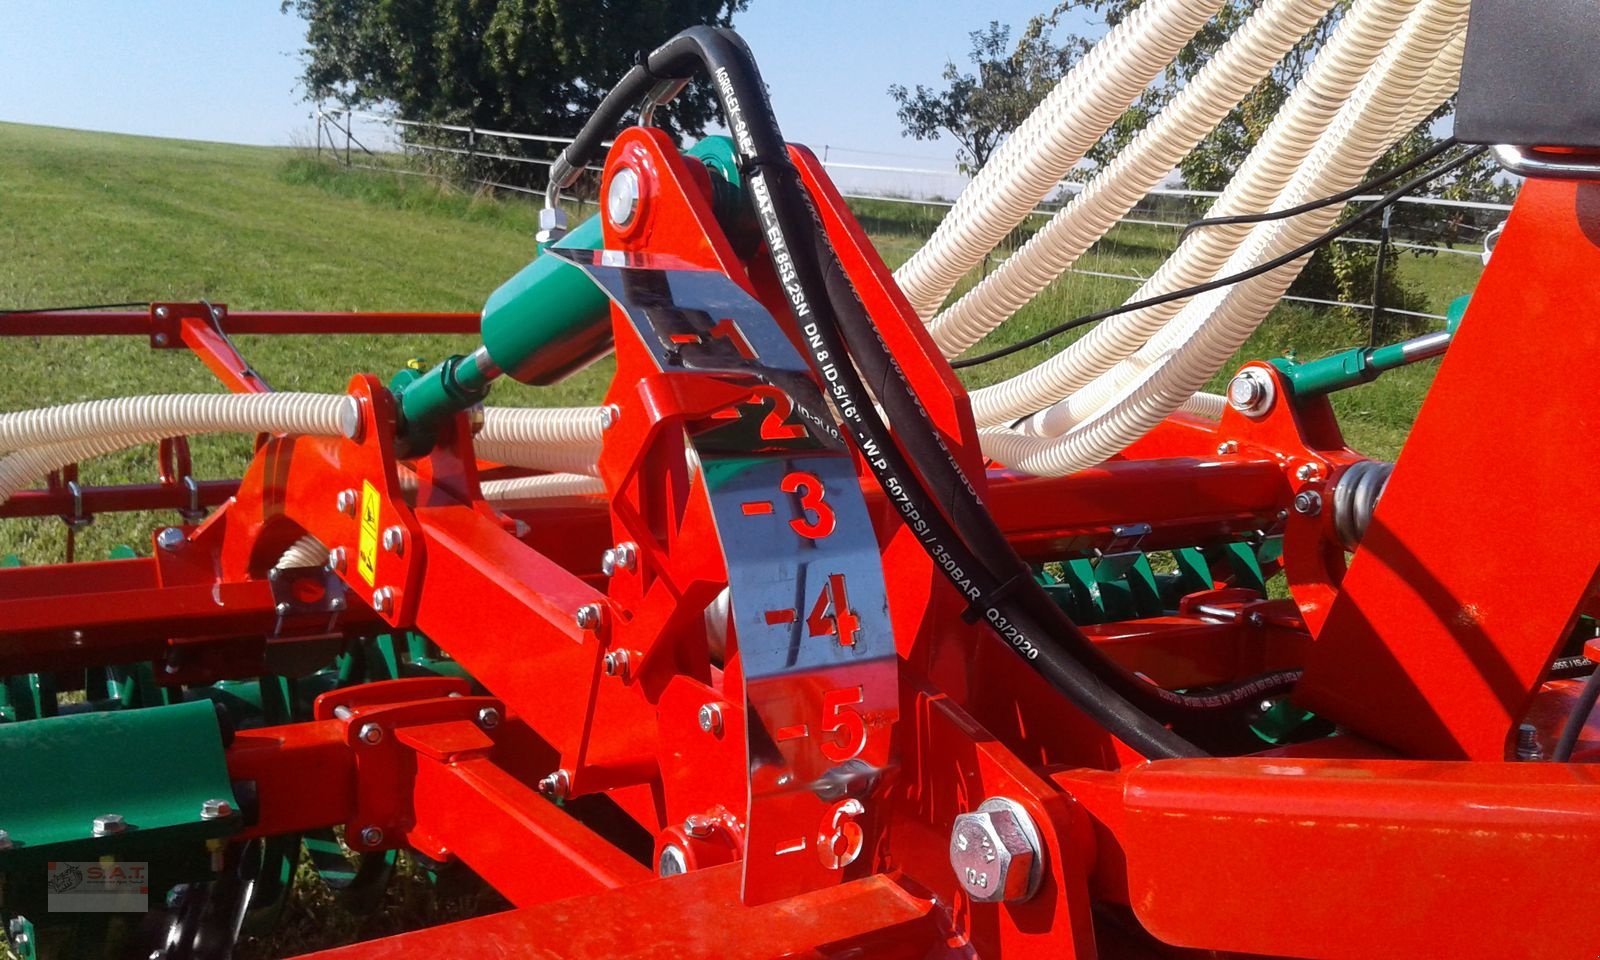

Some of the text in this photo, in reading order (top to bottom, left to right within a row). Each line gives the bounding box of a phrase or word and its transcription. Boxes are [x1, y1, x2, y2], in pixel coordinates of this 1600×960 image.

[715, 67, 741, 117] AGRIFLEX
[767, 226, 785, 251] EN
[776, 252, 796, 283] 853
[787, 283, 810, 317] 2SN
[804, 322, 824, 349] DN
[817, 350, 829, 362] 8
[885, 477, 931, 537] 5075PSI
[931, 544, 981, 601] 350BAR
[986, 607, 1040, 661] Q3/2020
